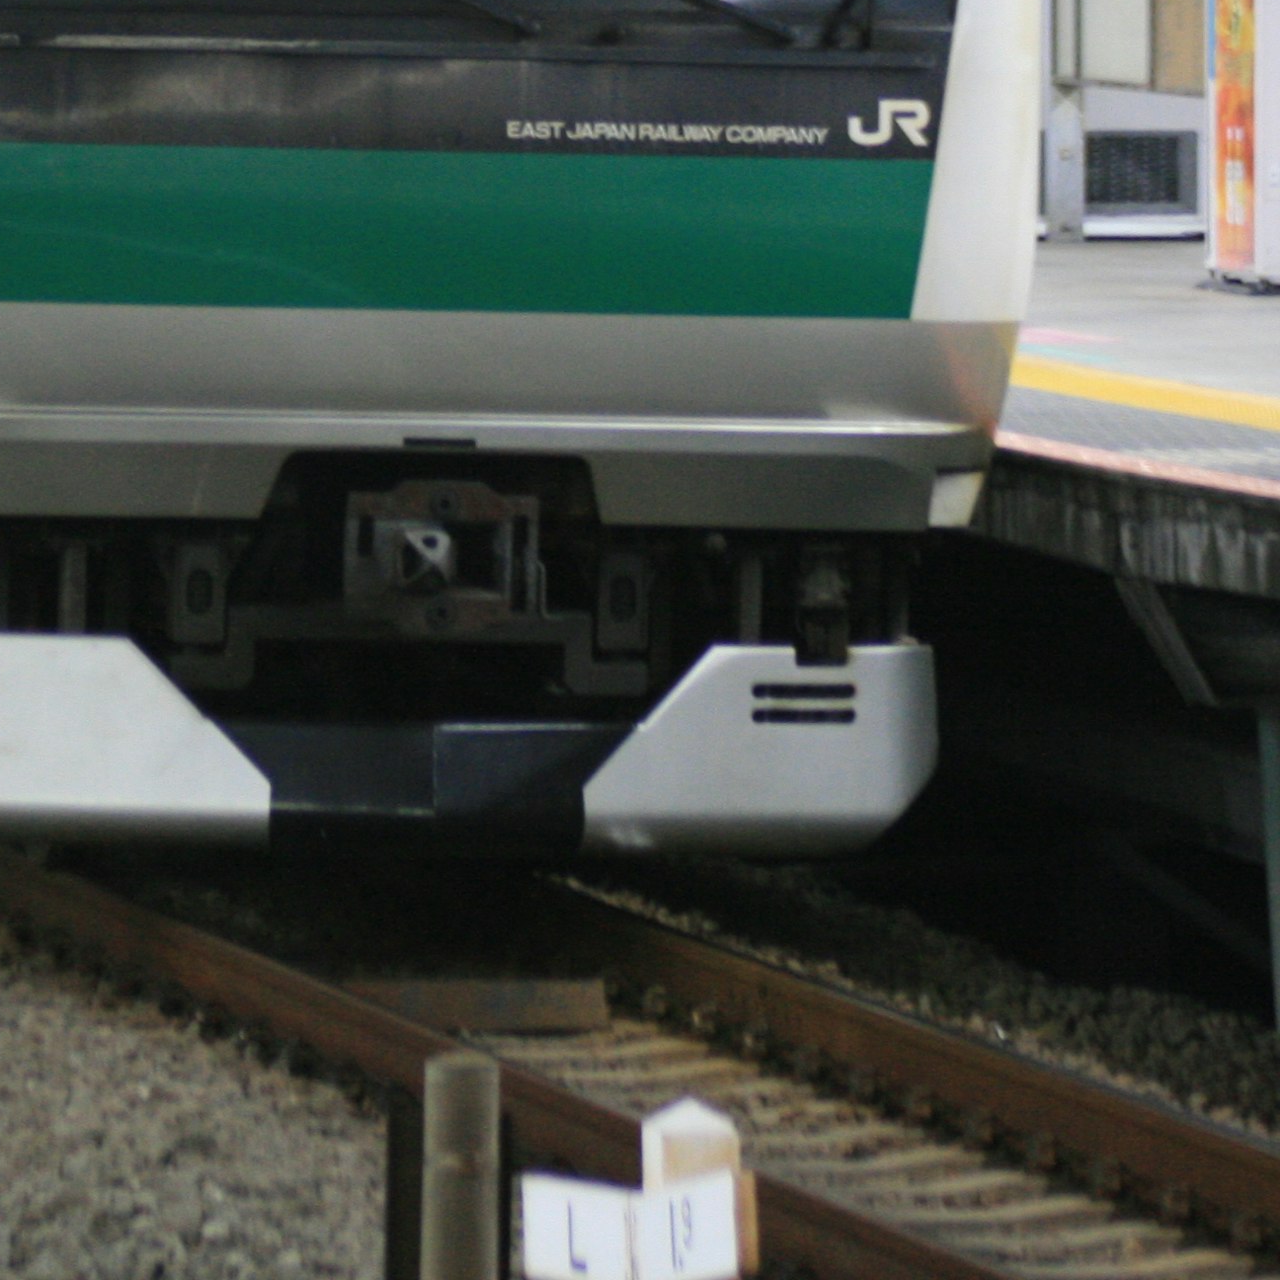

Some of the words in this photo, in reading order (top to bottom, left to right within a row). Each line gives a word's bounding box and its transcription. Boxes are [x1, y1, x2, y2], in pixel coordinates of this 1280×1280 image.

[506, 120, 566, 140] EAST
[567, 122, 636, 141] JAPAN
[638, 123, 725, 143] RAILWAY
[726, 125, 830, 145] COMPANY
[847, 98, 931, 148] JR
